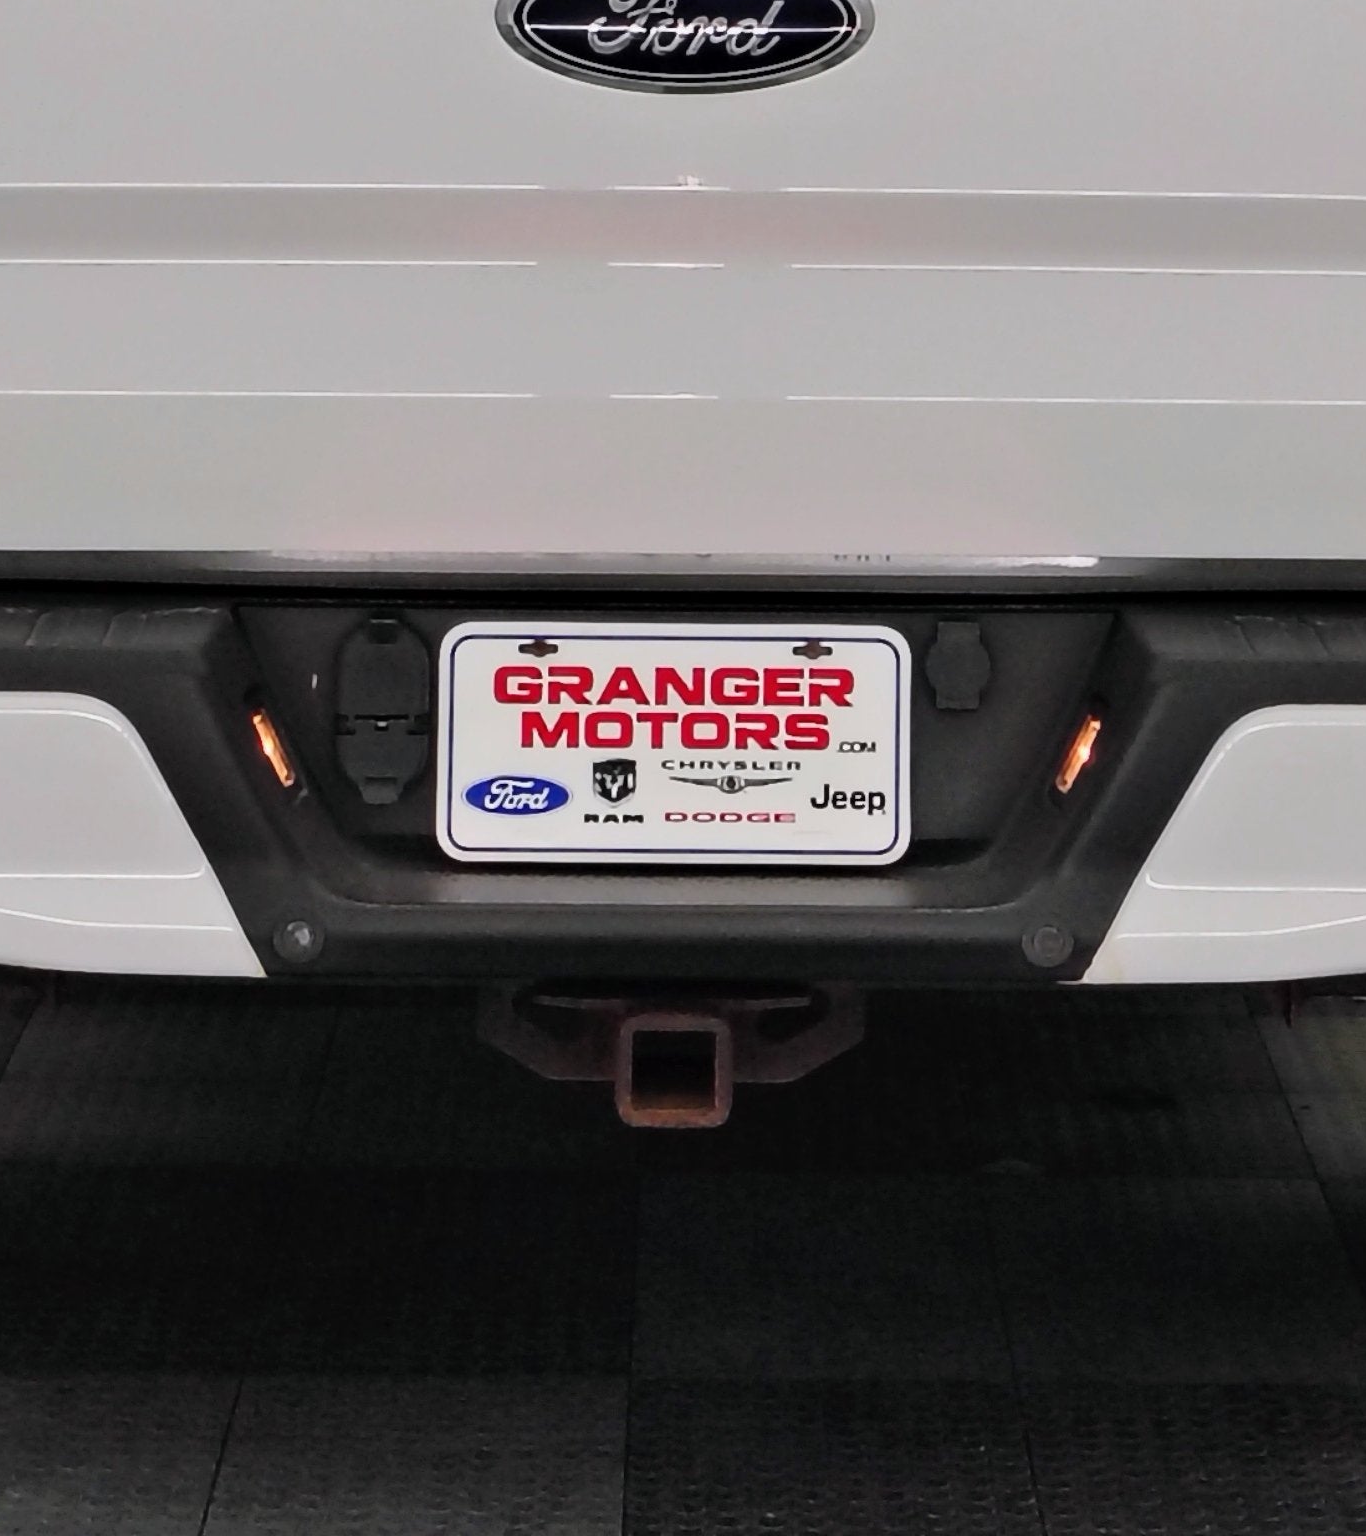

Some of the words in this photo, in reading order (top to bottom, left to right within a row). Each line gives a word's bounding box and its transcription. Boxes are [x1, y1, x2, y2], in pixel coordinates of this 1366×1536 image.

[493, 666, 855, 707] GRANGER
[520, 711, 830, 750] MOTORS
[661, 759, 802, 771] CHRYSLER
[482, 780, 550, 811] Ford
[810, 784, 887, 815] Jeep
[584, 813, 644, 823] RAM
[664, 811, 796, 823] DODGE
